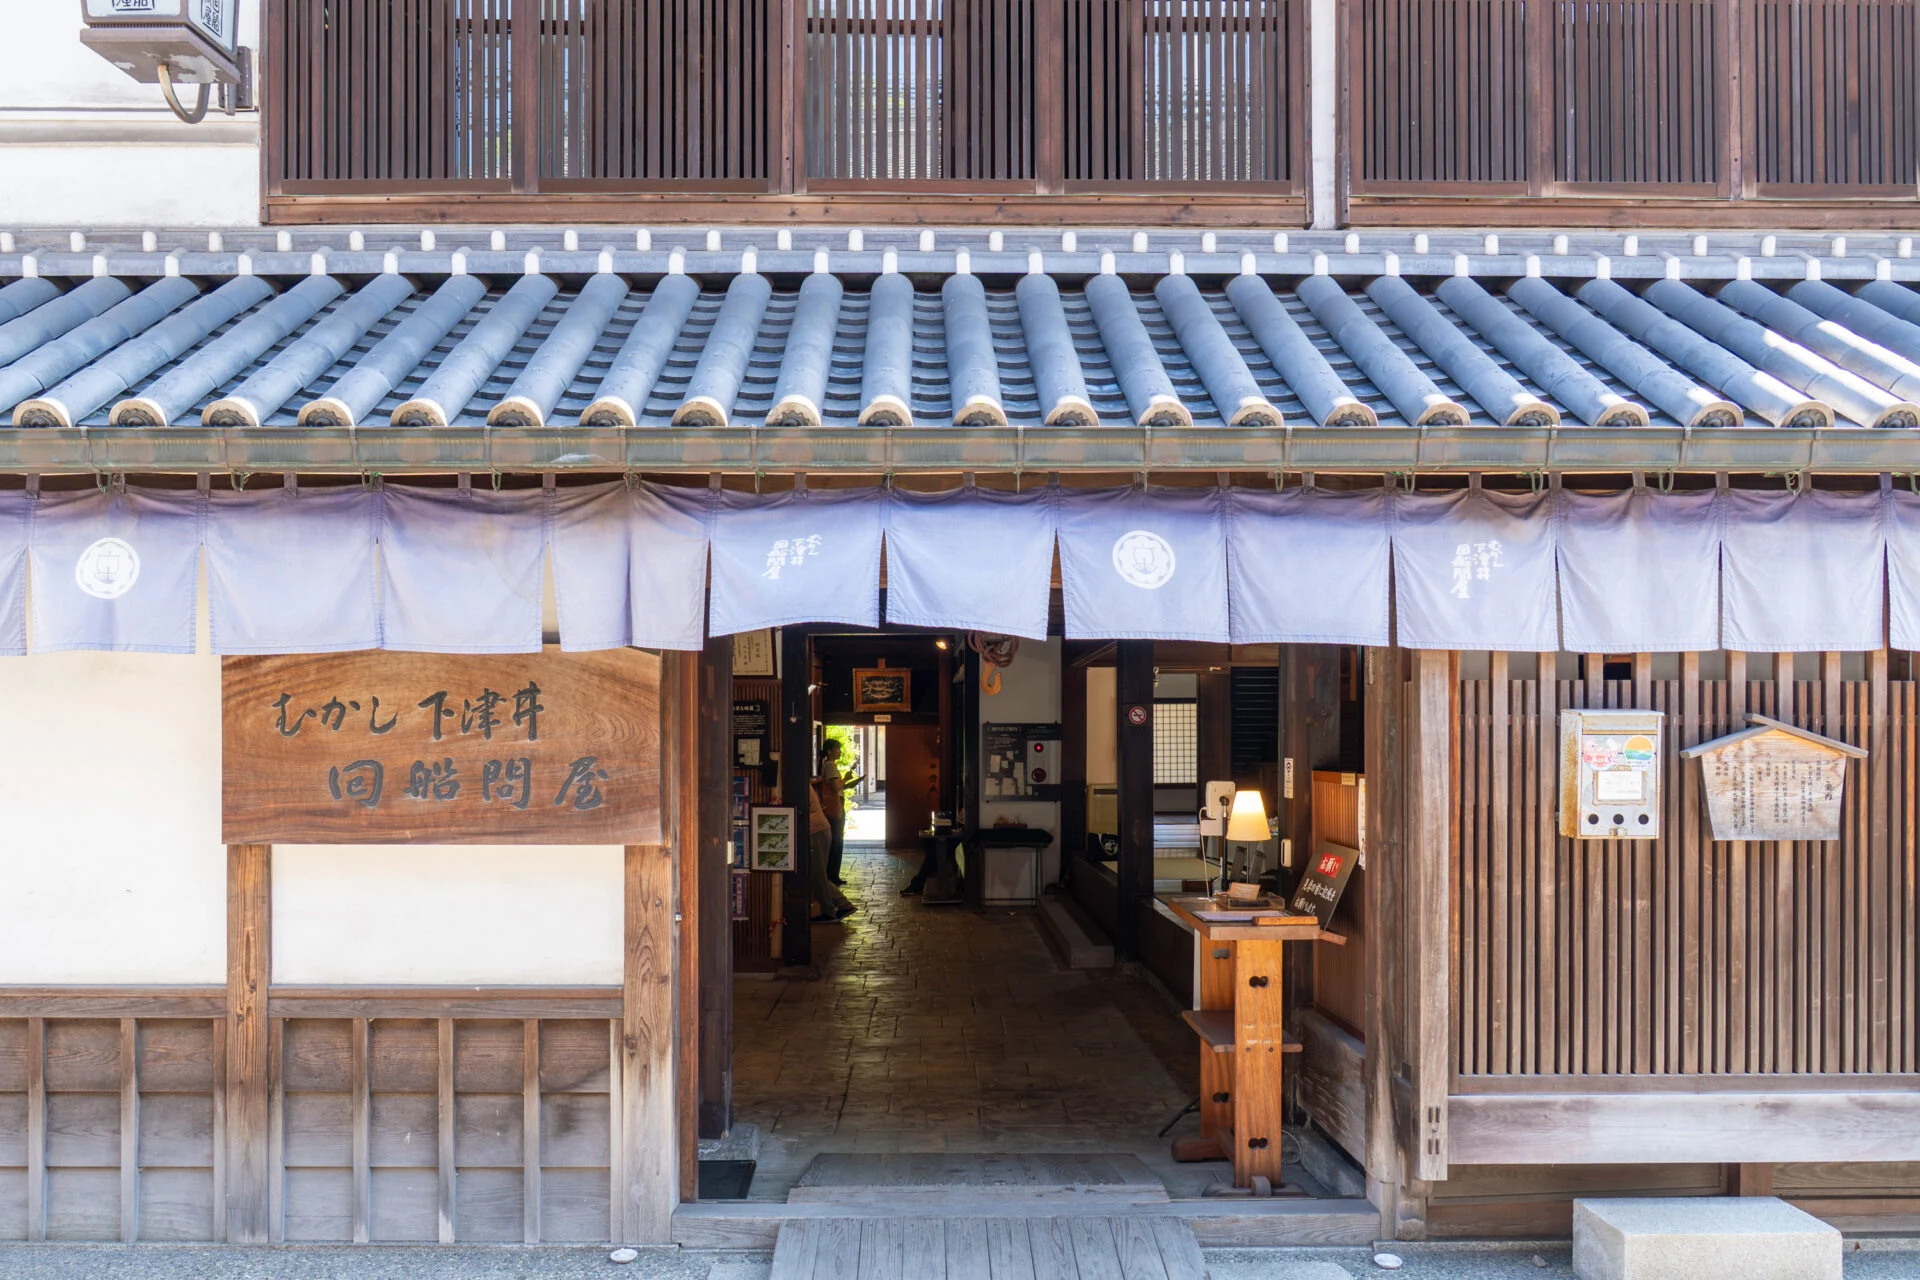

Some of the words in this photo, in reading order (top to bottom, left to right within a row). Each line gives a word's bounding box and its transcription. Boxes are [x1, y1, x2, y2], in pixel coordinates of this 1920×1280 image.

[328, 756, 609, 811] 回船問屋
[1320, 857, 1339, 873] お願い
